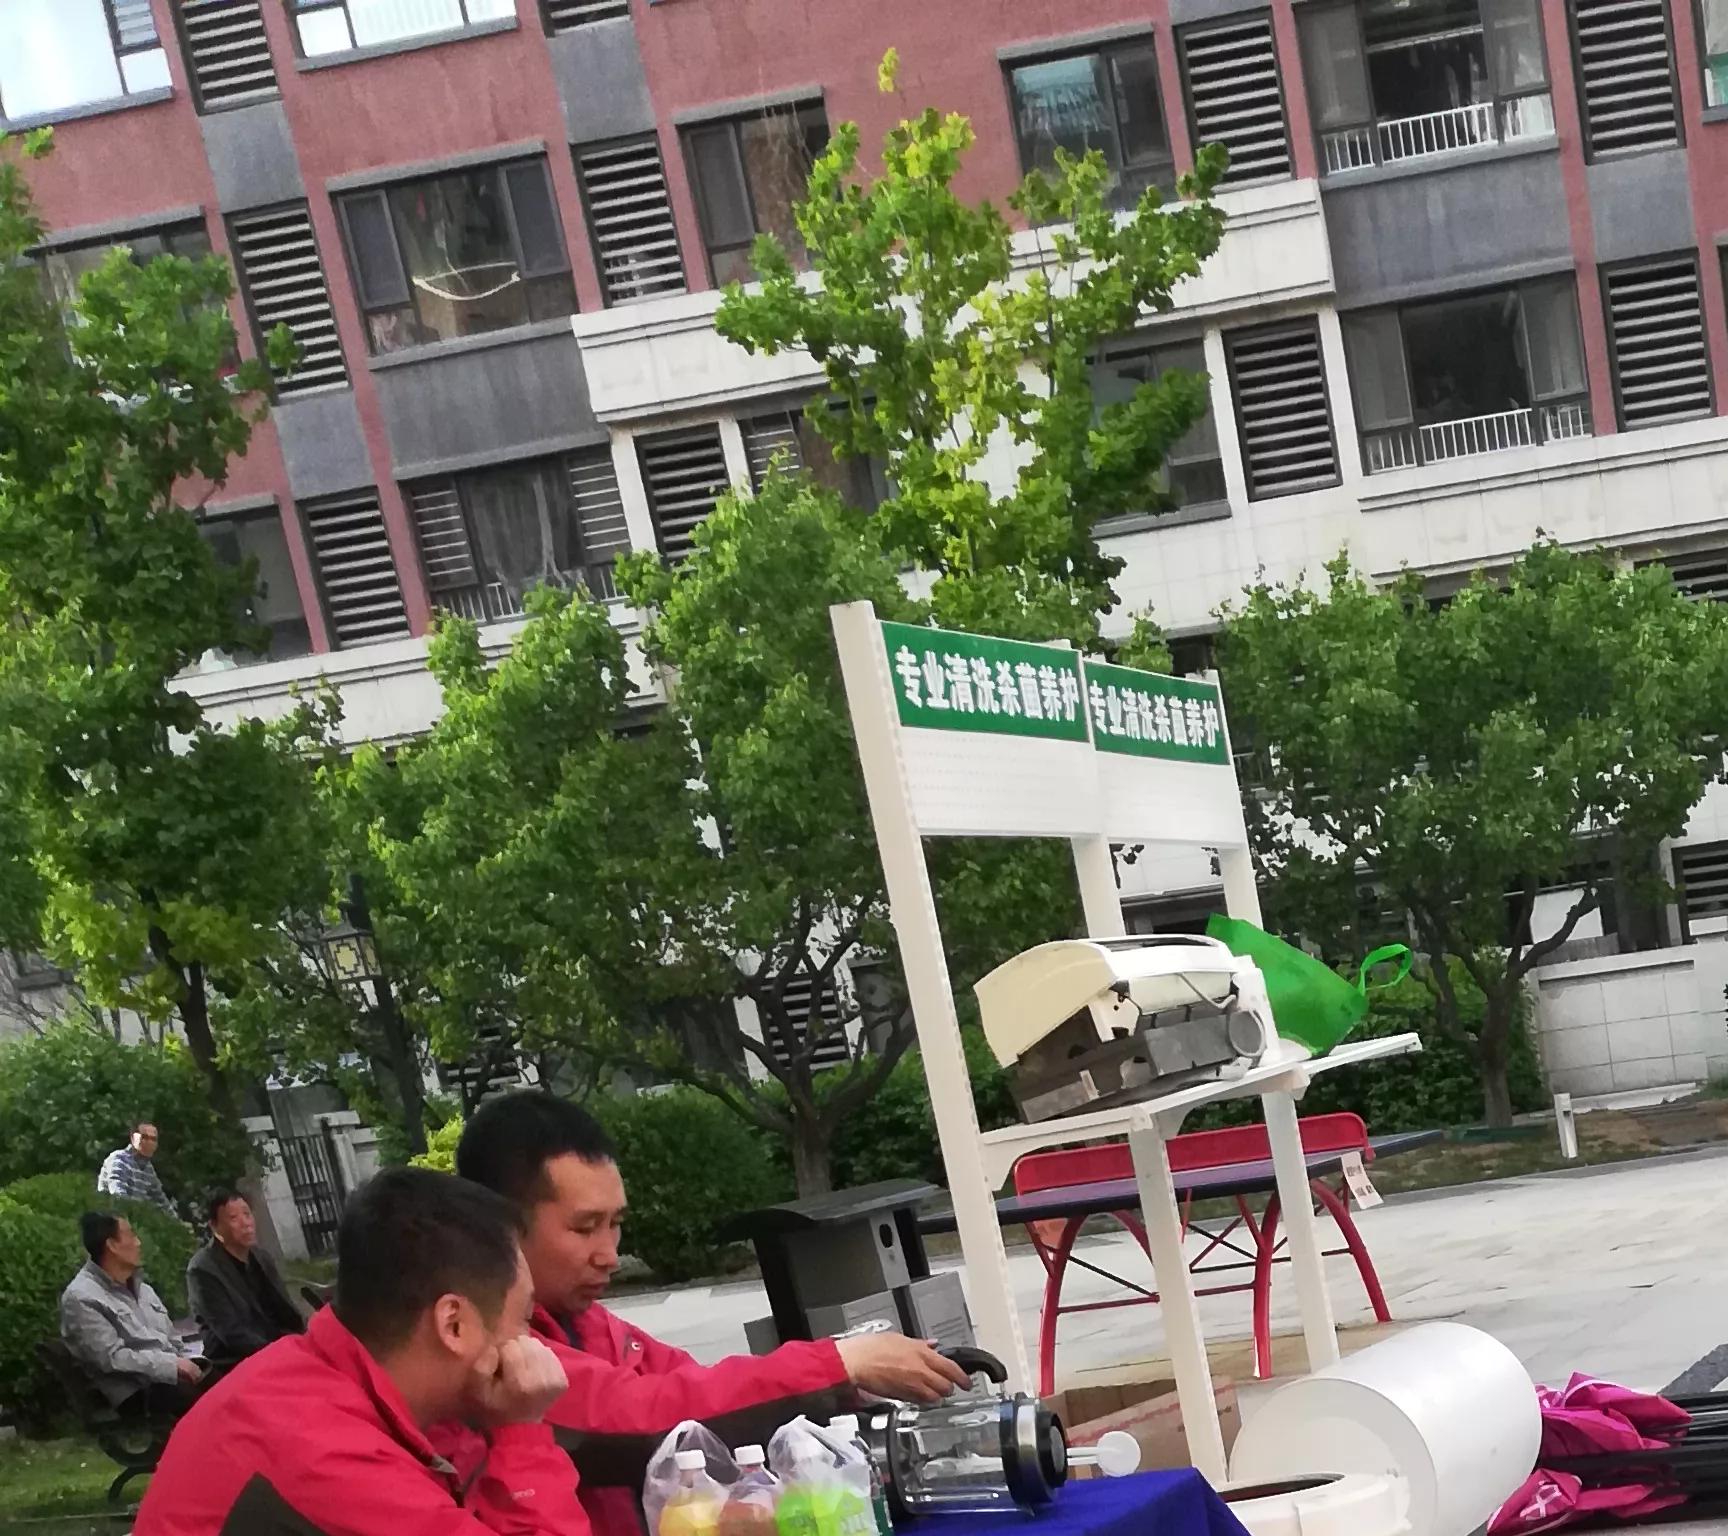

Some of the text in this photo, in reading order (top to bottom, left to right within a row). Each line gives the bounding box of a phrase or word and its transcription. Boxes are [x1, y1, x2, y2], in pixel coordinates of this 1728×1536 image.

[895, 645, 1080, 722] 专业清洗杀菌养护
[1089, 679, 1219, 748] 专业清洗杀菌养护
